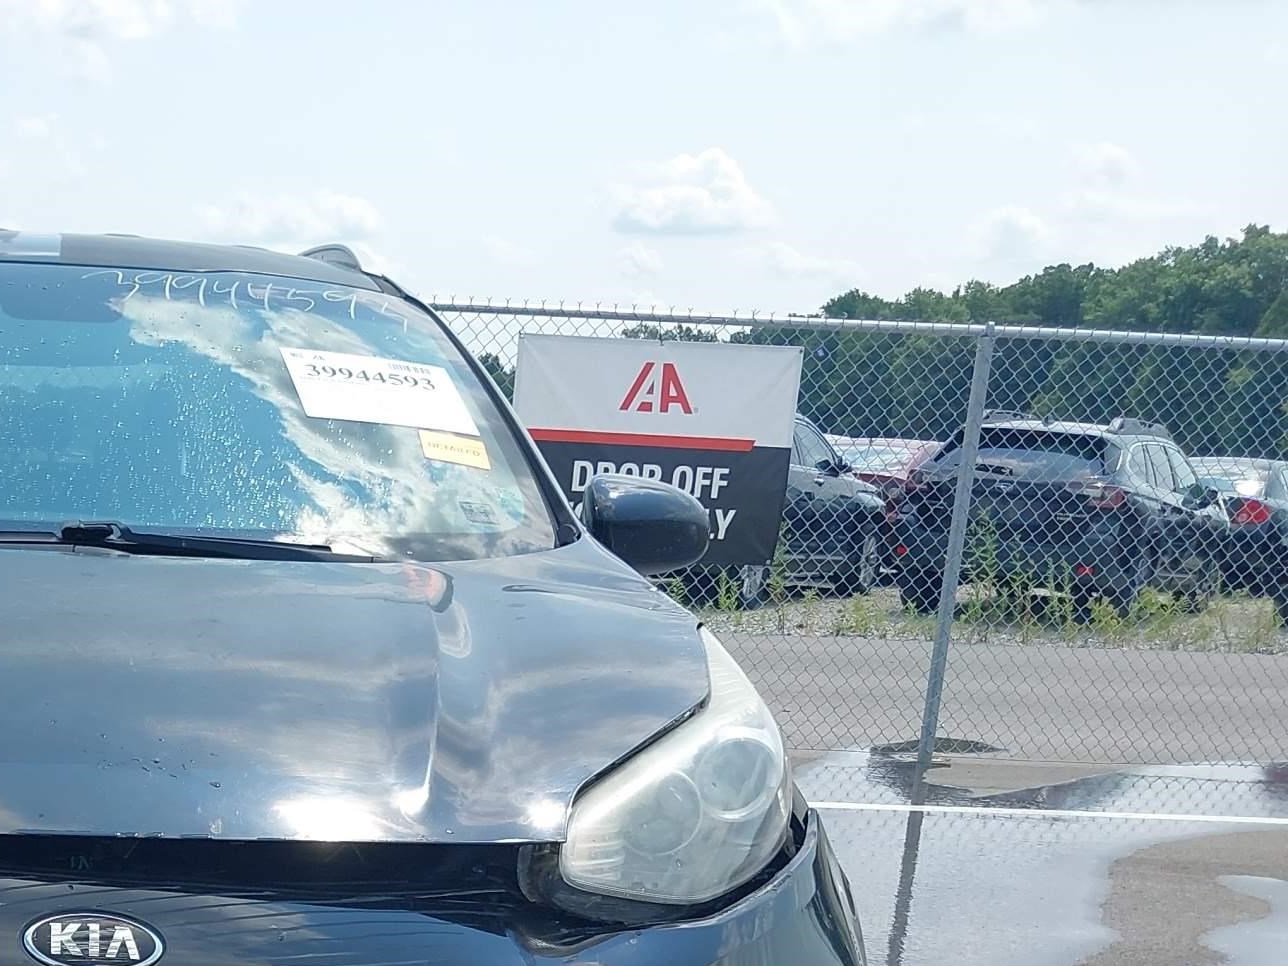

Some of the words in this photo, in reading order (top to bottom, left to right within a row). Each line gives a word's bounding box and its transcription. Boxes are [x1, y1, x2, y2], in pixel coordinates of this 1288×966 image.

[304, 364, 437, 391] 39944593
[671, 465, 730, 499] OFF
[49, 922, 140, 960] KIA
